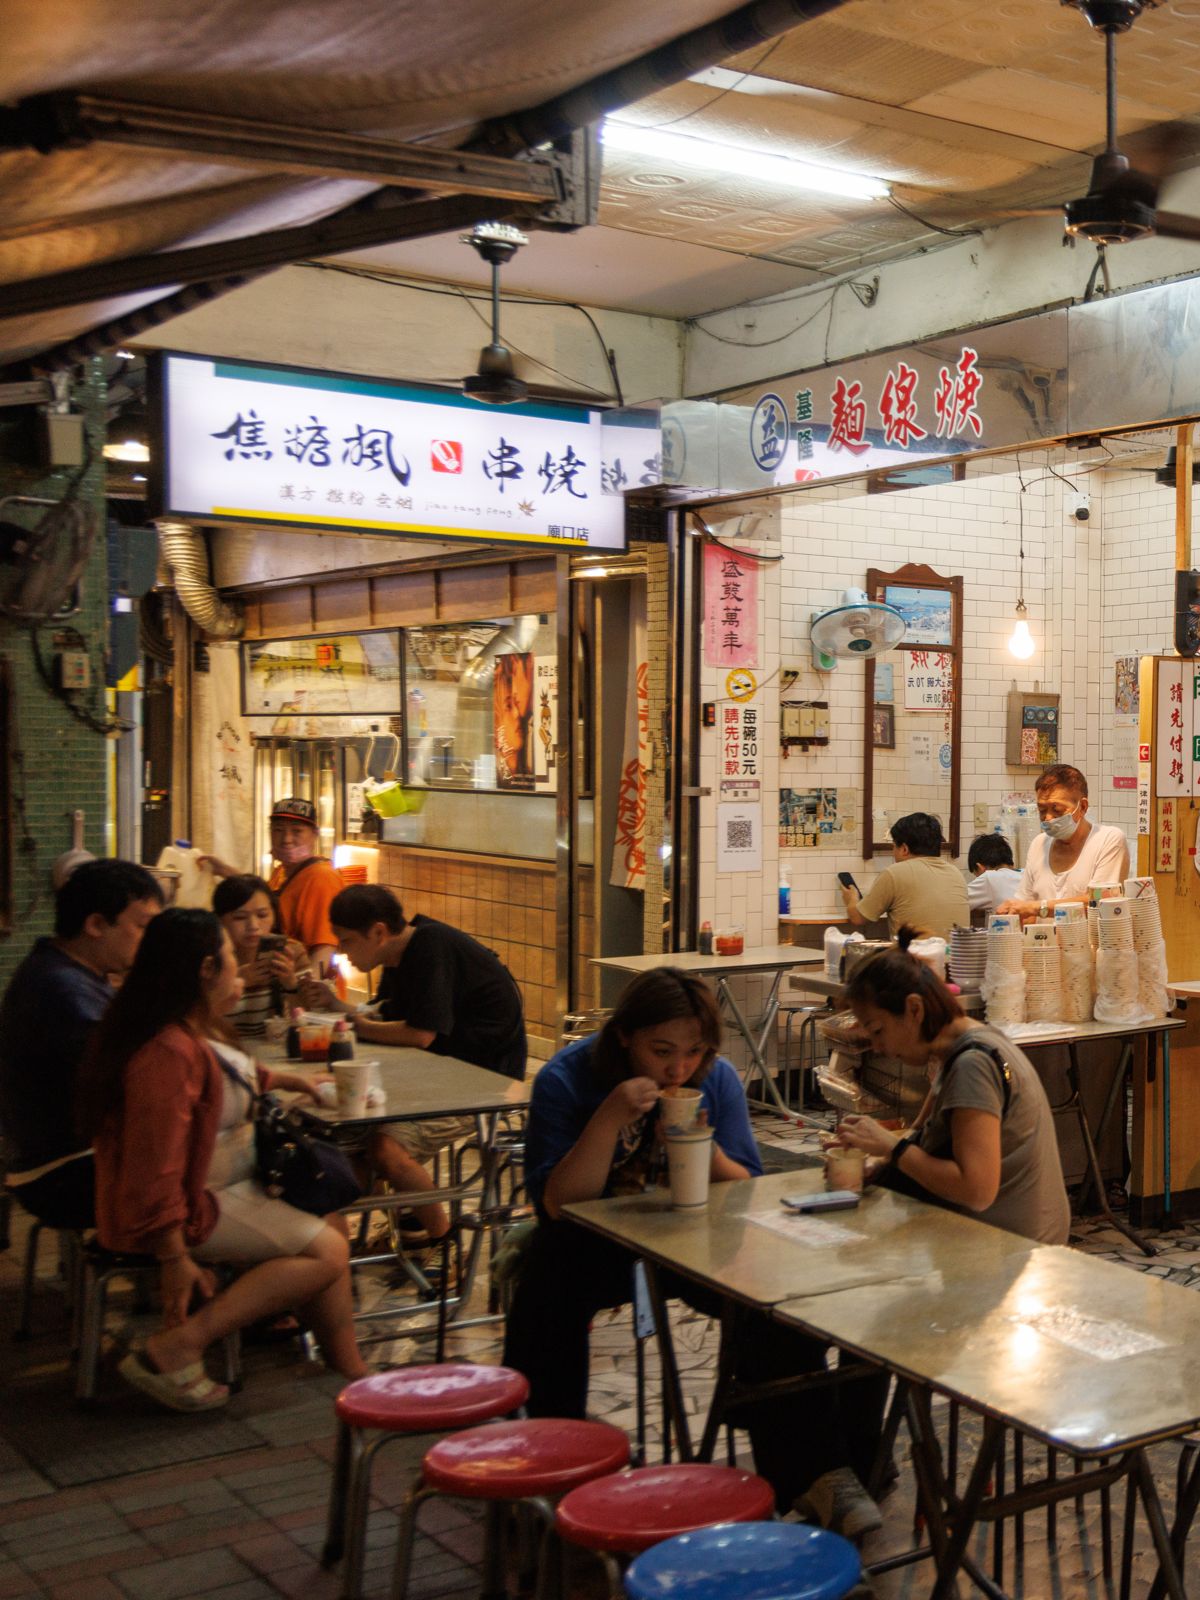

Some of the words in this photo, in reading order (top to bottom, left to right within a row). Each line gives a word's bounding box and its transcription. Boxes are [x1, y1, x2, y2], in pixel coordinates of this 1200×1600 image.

[827, 346, 984, 457] 麵線焿
[481, 436, 590, 499] 串燒
[547, 525, 589, 542] 廟口店
[724, 708, 740, 776] 請先付款
[742, 709, 757, 776] 每碗50元
[1169, 682, 1184, 778] 請先付款
[1161, 801, 1173, 866] 請先付款
